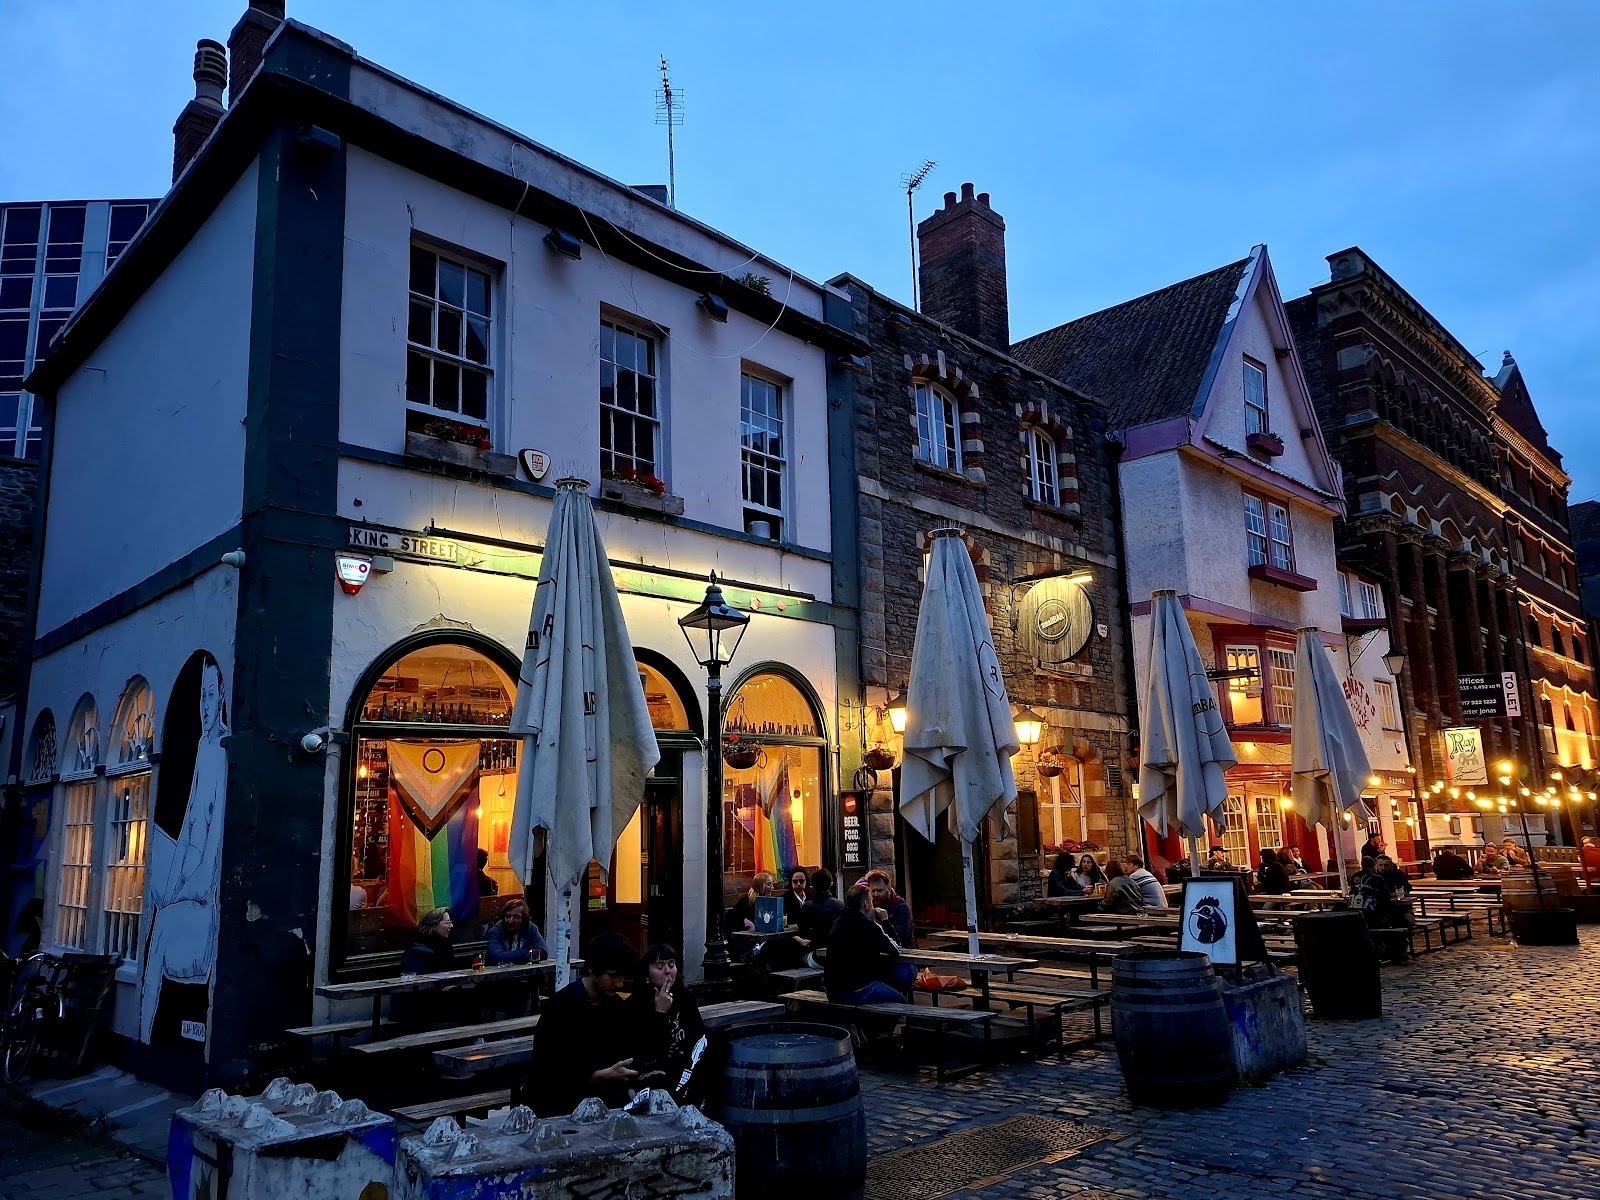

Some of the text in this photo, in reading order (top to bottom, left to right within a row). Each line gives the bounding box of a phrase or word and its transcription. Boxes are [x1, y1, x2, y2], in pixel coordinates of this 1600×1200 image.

[353, 529, 454, 558] KING STREET
[1504, 674, 1517, 712] TO LET
[844, 816, 860, 827] BEER.
[845, 829, 860, 840] FOOD.
